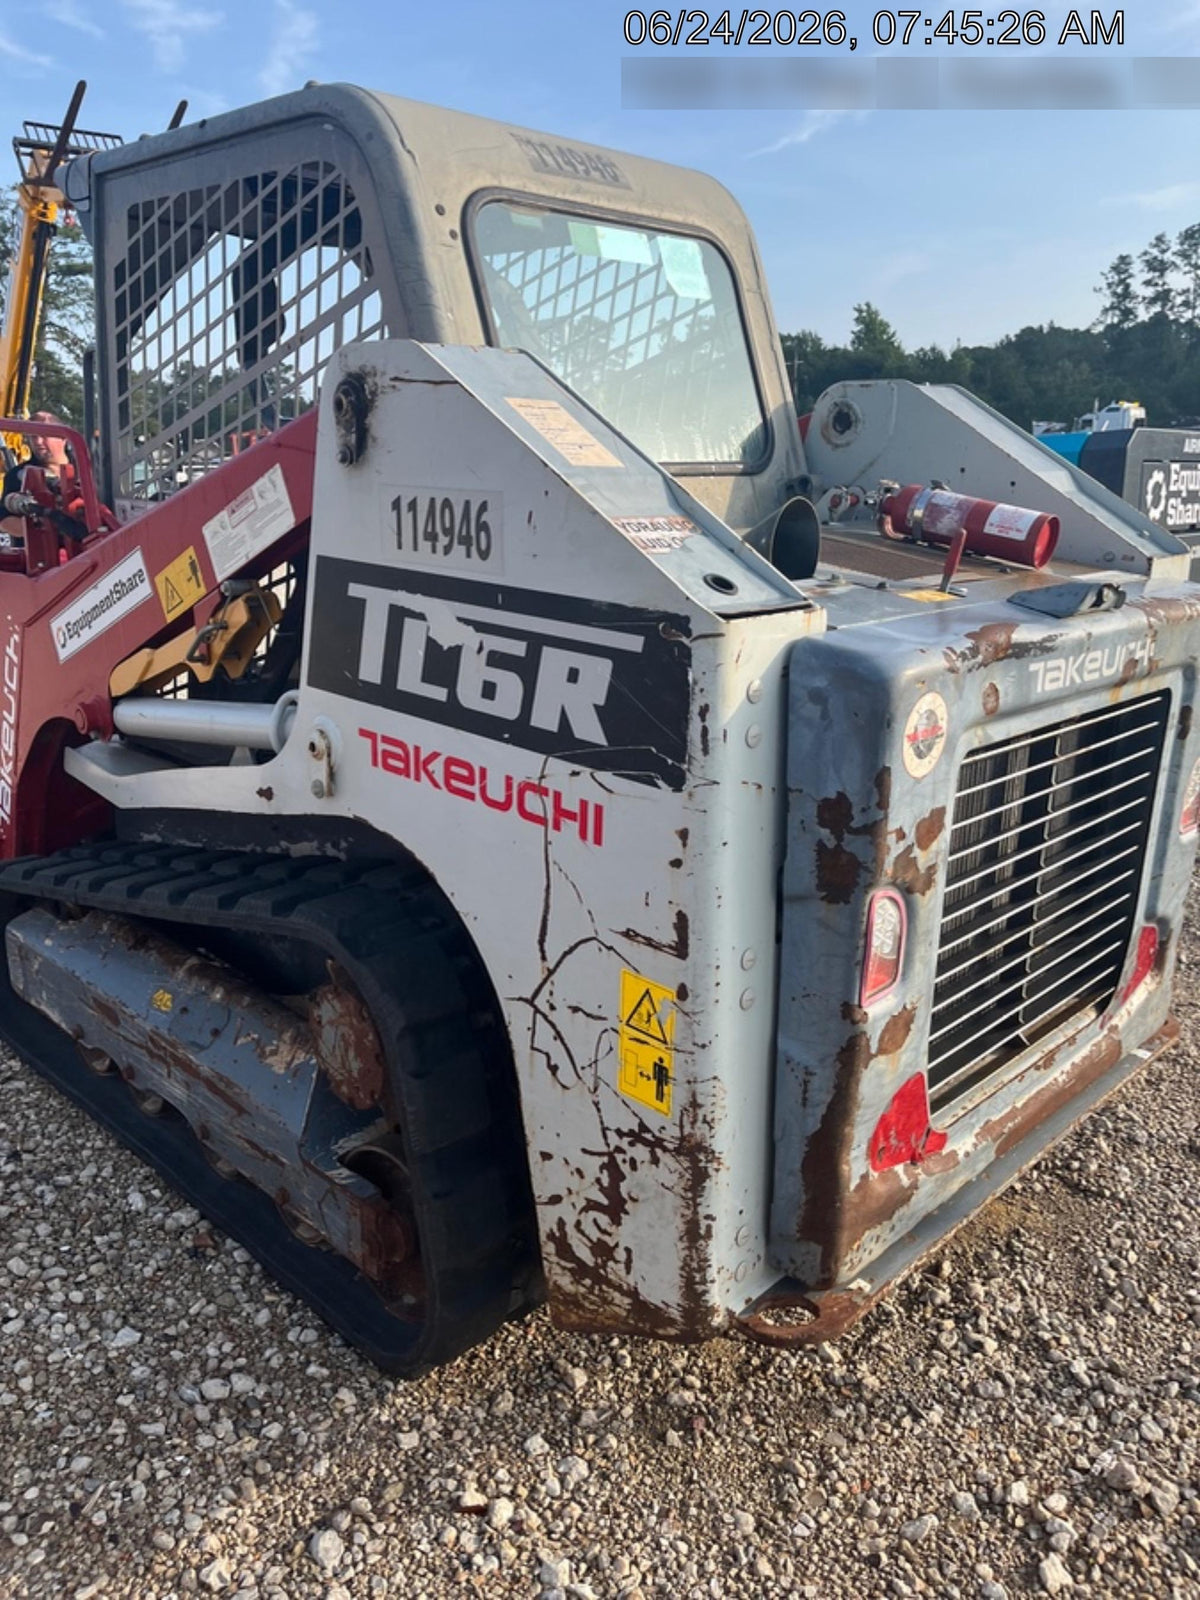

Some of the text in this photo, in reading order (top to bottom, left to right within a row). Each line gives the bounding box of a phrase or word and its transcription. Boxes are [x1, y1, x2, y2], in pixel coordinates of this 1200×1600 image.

[391, 494, 492, 562] 114946
[65, 568, 146, 641] EquipmentShare
[347, 582, 645, 747] TL6R
